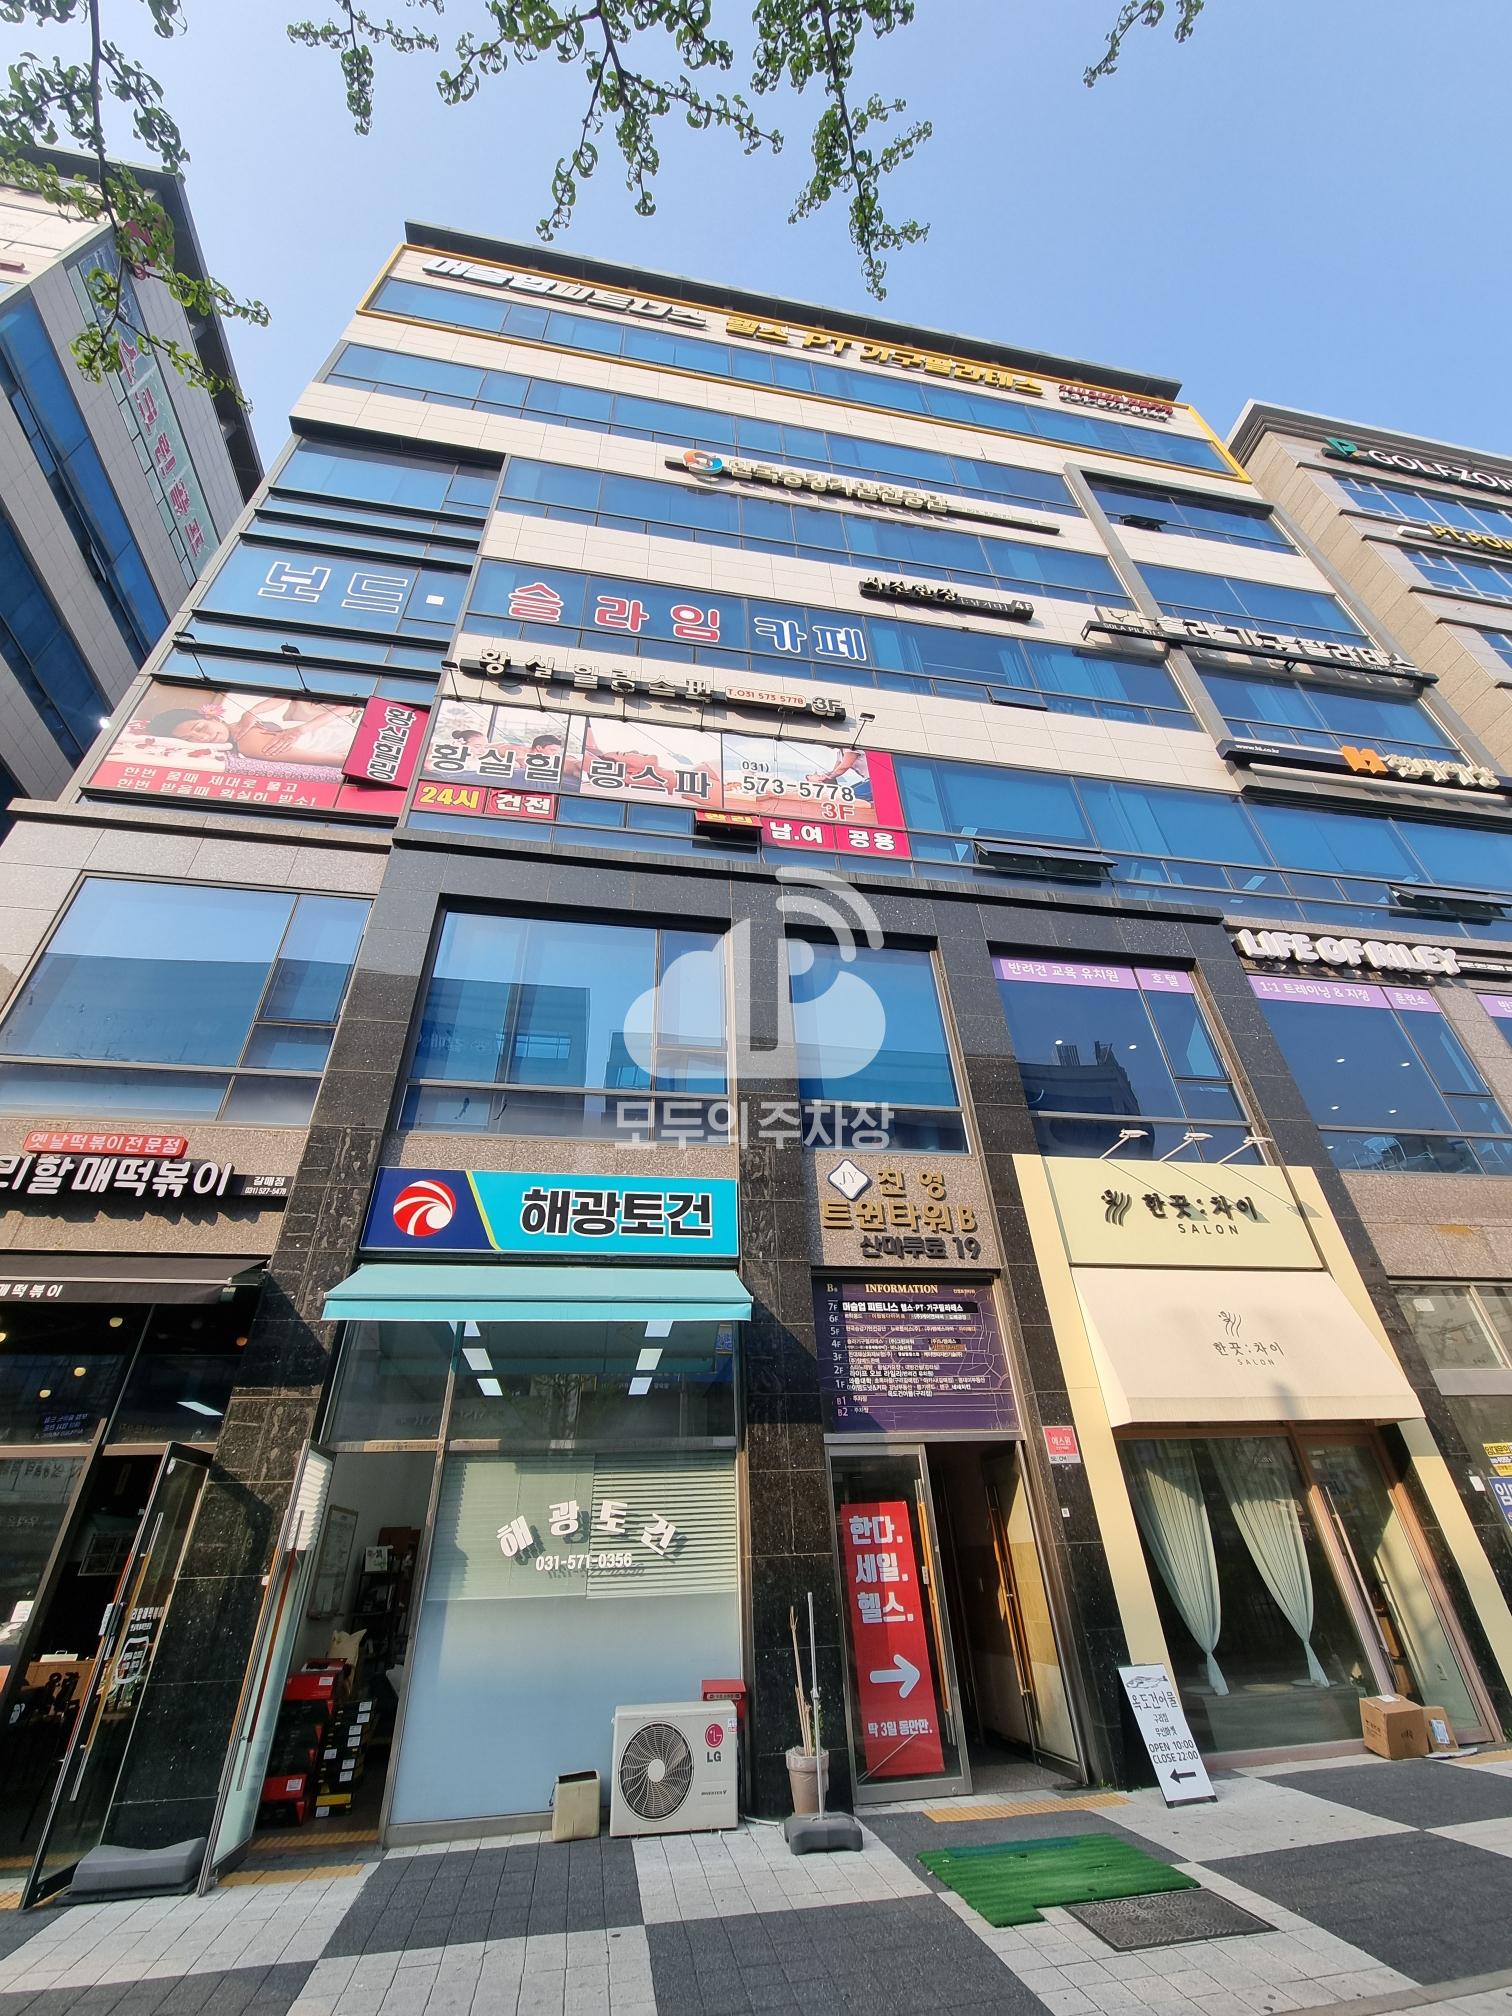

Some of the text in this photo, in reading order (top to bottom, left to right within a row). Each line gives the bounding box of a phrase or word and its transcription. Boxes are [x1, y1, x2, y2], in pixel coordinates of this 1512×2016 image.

[803, 331, 851, 357] PT
[860, 343, 1044, 397] 기구필라테스
[1429, 524, 1461, 542] PT
[256, 560, 869, 663] 보드 슬라임 카페
[480, 648, 713, 704] 황실힐링스파
[757, 689, 777, 701] 573
[812, 696, 844, 717] 3F
[367, 706, 415, 782] 황실힐링
[430, 741, 713, 800] 황실힐링스파
[741, 760, 770, 774] 031)
[208, 774, 257, 788] 제대로
[742, 773, 855, 803] 573-5778
[419, 785, 552, 816] 24시 건전
[821, 802, 855, 821] 3F
[769, 822, 824, 845] 남.여
[847, 828, 896, 851] 공용
[1236, 928, 1461, 976] LIFE OF RILEY
[1008, 961, 1181, 987] 반려견 교육 유치원 호텔
[1259, 981, 1280, 993] 1:1
[1283, 983, 1329, 999] 트레이닝
[1332, 987, 1344, 998] &
[1393, 992, 1429, 1005] 훈련소
[30, 1133, 181, 1153] 옛날떡볶이전문점
[521, 1186, 713, 1238] 해광토건
[1178, 1223, 1239, 1235] SALON
[860, 1235, 982, 1260] 산마루로 19
[865, 1283, 938, 1294] INFORMATION
[828, 1302, 839, 1312] 7F
[829, 1314, 839, 1323] 6F
[830, 1327, 840, 1336] 5F
[831, 1339, 842, 1348] 4F
[832, 1352, 843, 1361] 3F
[1237, 1358, 1276, 1367] SALON
[834, 1366, 844, 1374] 2F
[836, 1380, 846, 1388] 1F
[836, 1396, 846, 1406] B1
[837, 1408, 849, 1417] B2
[496, 1499, 677, 1558] 해광토건
[848, 1515, 904, 1545] 한다.
[535, 1553, 633, 1571] 031-571-0356
[855, 1552, 909, 1583] 세일.
[857, 1591, 914, 1624] 헬스.
[1132, 1691, 1179, 1711] 옥도건어물
[868, 1722, 879, 1738] 딱
[880, 1721, 897, 1737] 3일
[1148, 1739, 1195, 1753] OPEN 10:00
[706, 1751, 722, 1763] LG
[1153, 1750, 1199, 1765] CLOSE 22:00
